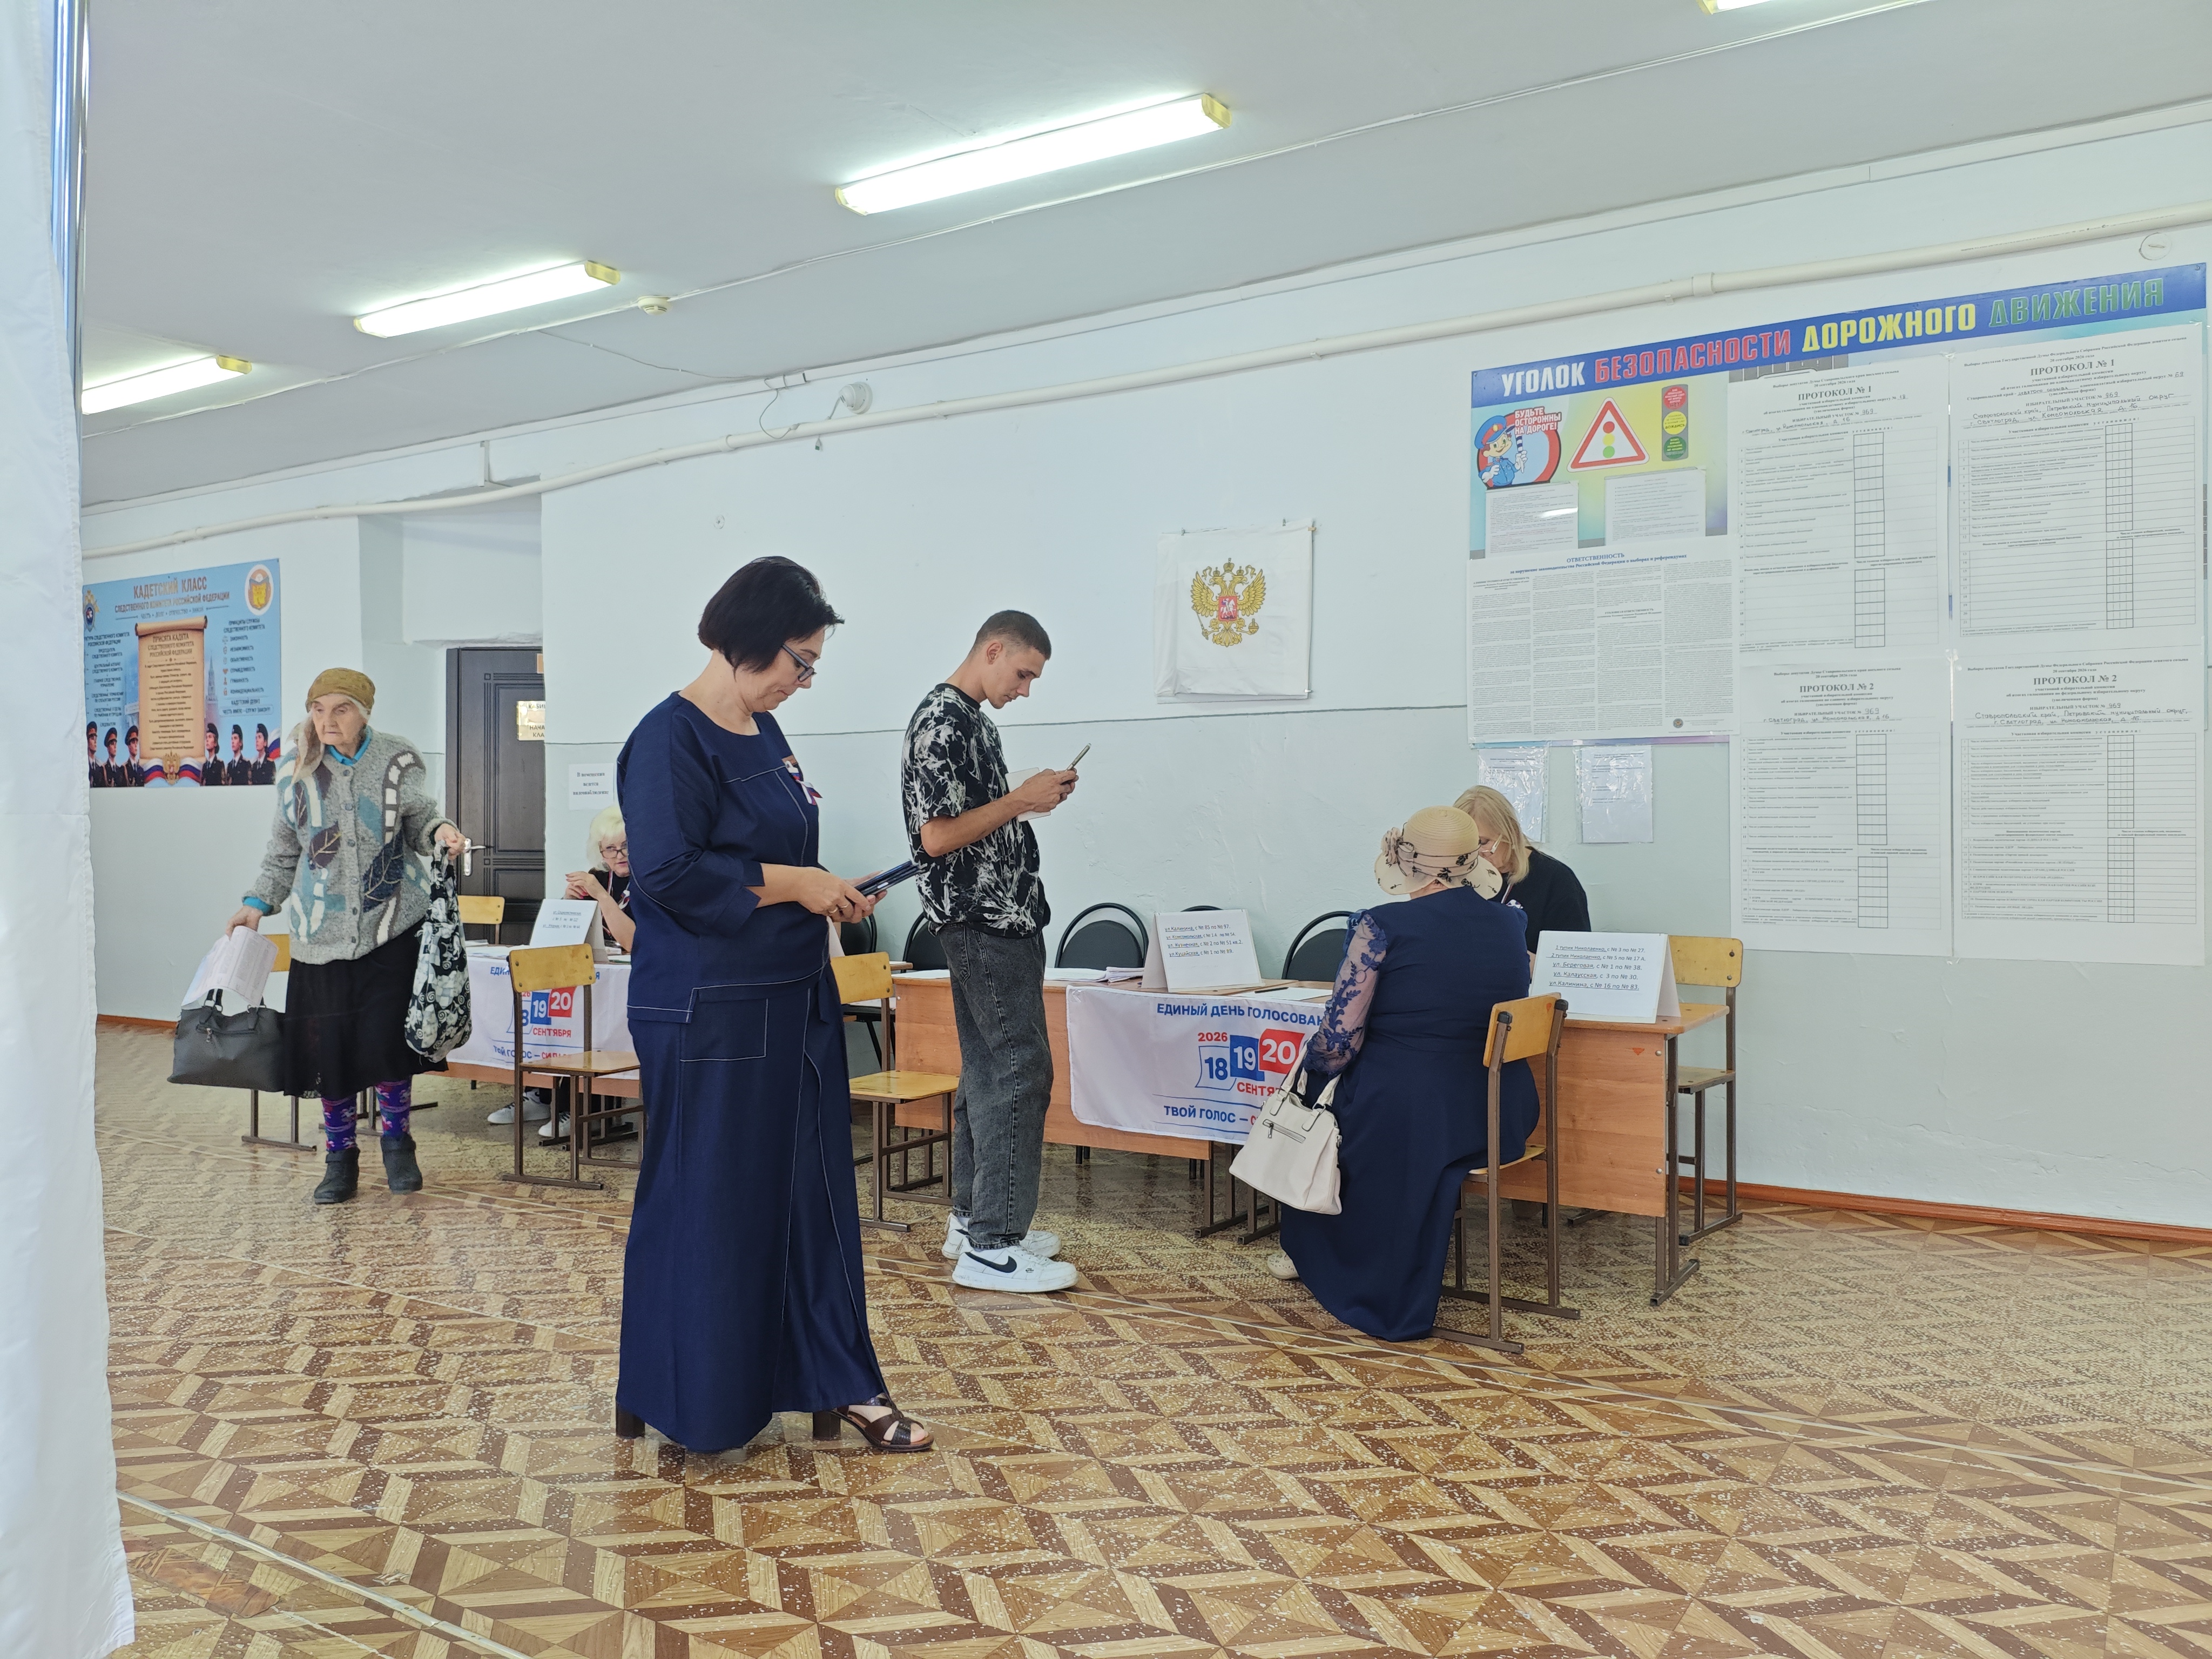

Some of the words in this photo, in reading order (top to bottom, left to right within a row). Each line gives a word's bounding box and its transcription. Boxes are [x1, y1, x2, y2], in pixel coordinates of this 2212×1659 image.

[1501, 362, 1585, 396] УГОЛОК
[1595, 330, 1790, 383] БЕЗОПАСНОСТИ
[1802, 303, 1975, 353] ДОРОЖНОГО
[1990, 278, 2163, 328] ДВИЖЕНИЯ
[2031, 361, 2093, 376] ПРОТОКОЛ
[2096, 360, 2107, 368] №
[1798, 388, 1852, 401] ПРОТОКОЛ
[1515, 407, 1544, 418] БУДЬТЕ
[1515, 413, 1561, 426] ОСТОРОЖНЫ
[1515, 427, 1525, 435] НА
[1527, 422, 1557, 435] ДОРОГЕ!
[1567, 552, 1624, 563] ОТВЕТСТВЕННОСТЬ
[133, 577, 178, 599] КАДЕТСКИЙ
[181, 576, 207, 593] КЛАСС
[114, 601, 149, 613] СЛЕДСТВЕННОГО
[2033, 675, 2095, 685] ПРОТОКОЛ
[1799, 684, 1854, 693] ПРОТОКОЛ
[522, 1009, 529, 1026] 8
[532, 1000, 547, 1019] 19
[550, 992, 571, 1010] 20
[1157, 1003, 1208, 1016] ЕДИНЫЙ
[1210, 1005, 1245, 1017] ДЕНЬ
[1248, 1007, 1323, 1026] ГОЛОСОВАН
[532, 1027, 571, 1038] СЕНТЯБРЯ
[1197, 1031, 1228, 1042] 2026
[507, 1049, 532, 1059] ГООС
[1204, 1057, 1228, 1080] 18
[1233, 1046, 1257, 1070] 19
[1262, 1039, 1296, 1064] 20
[1237, 1082, 1279, 1097] СЕНТЯ
[1164, 1105, 1196, 1118] ТВОЙ
[1199, 1108, 1236, 1123] ГОЛОС
